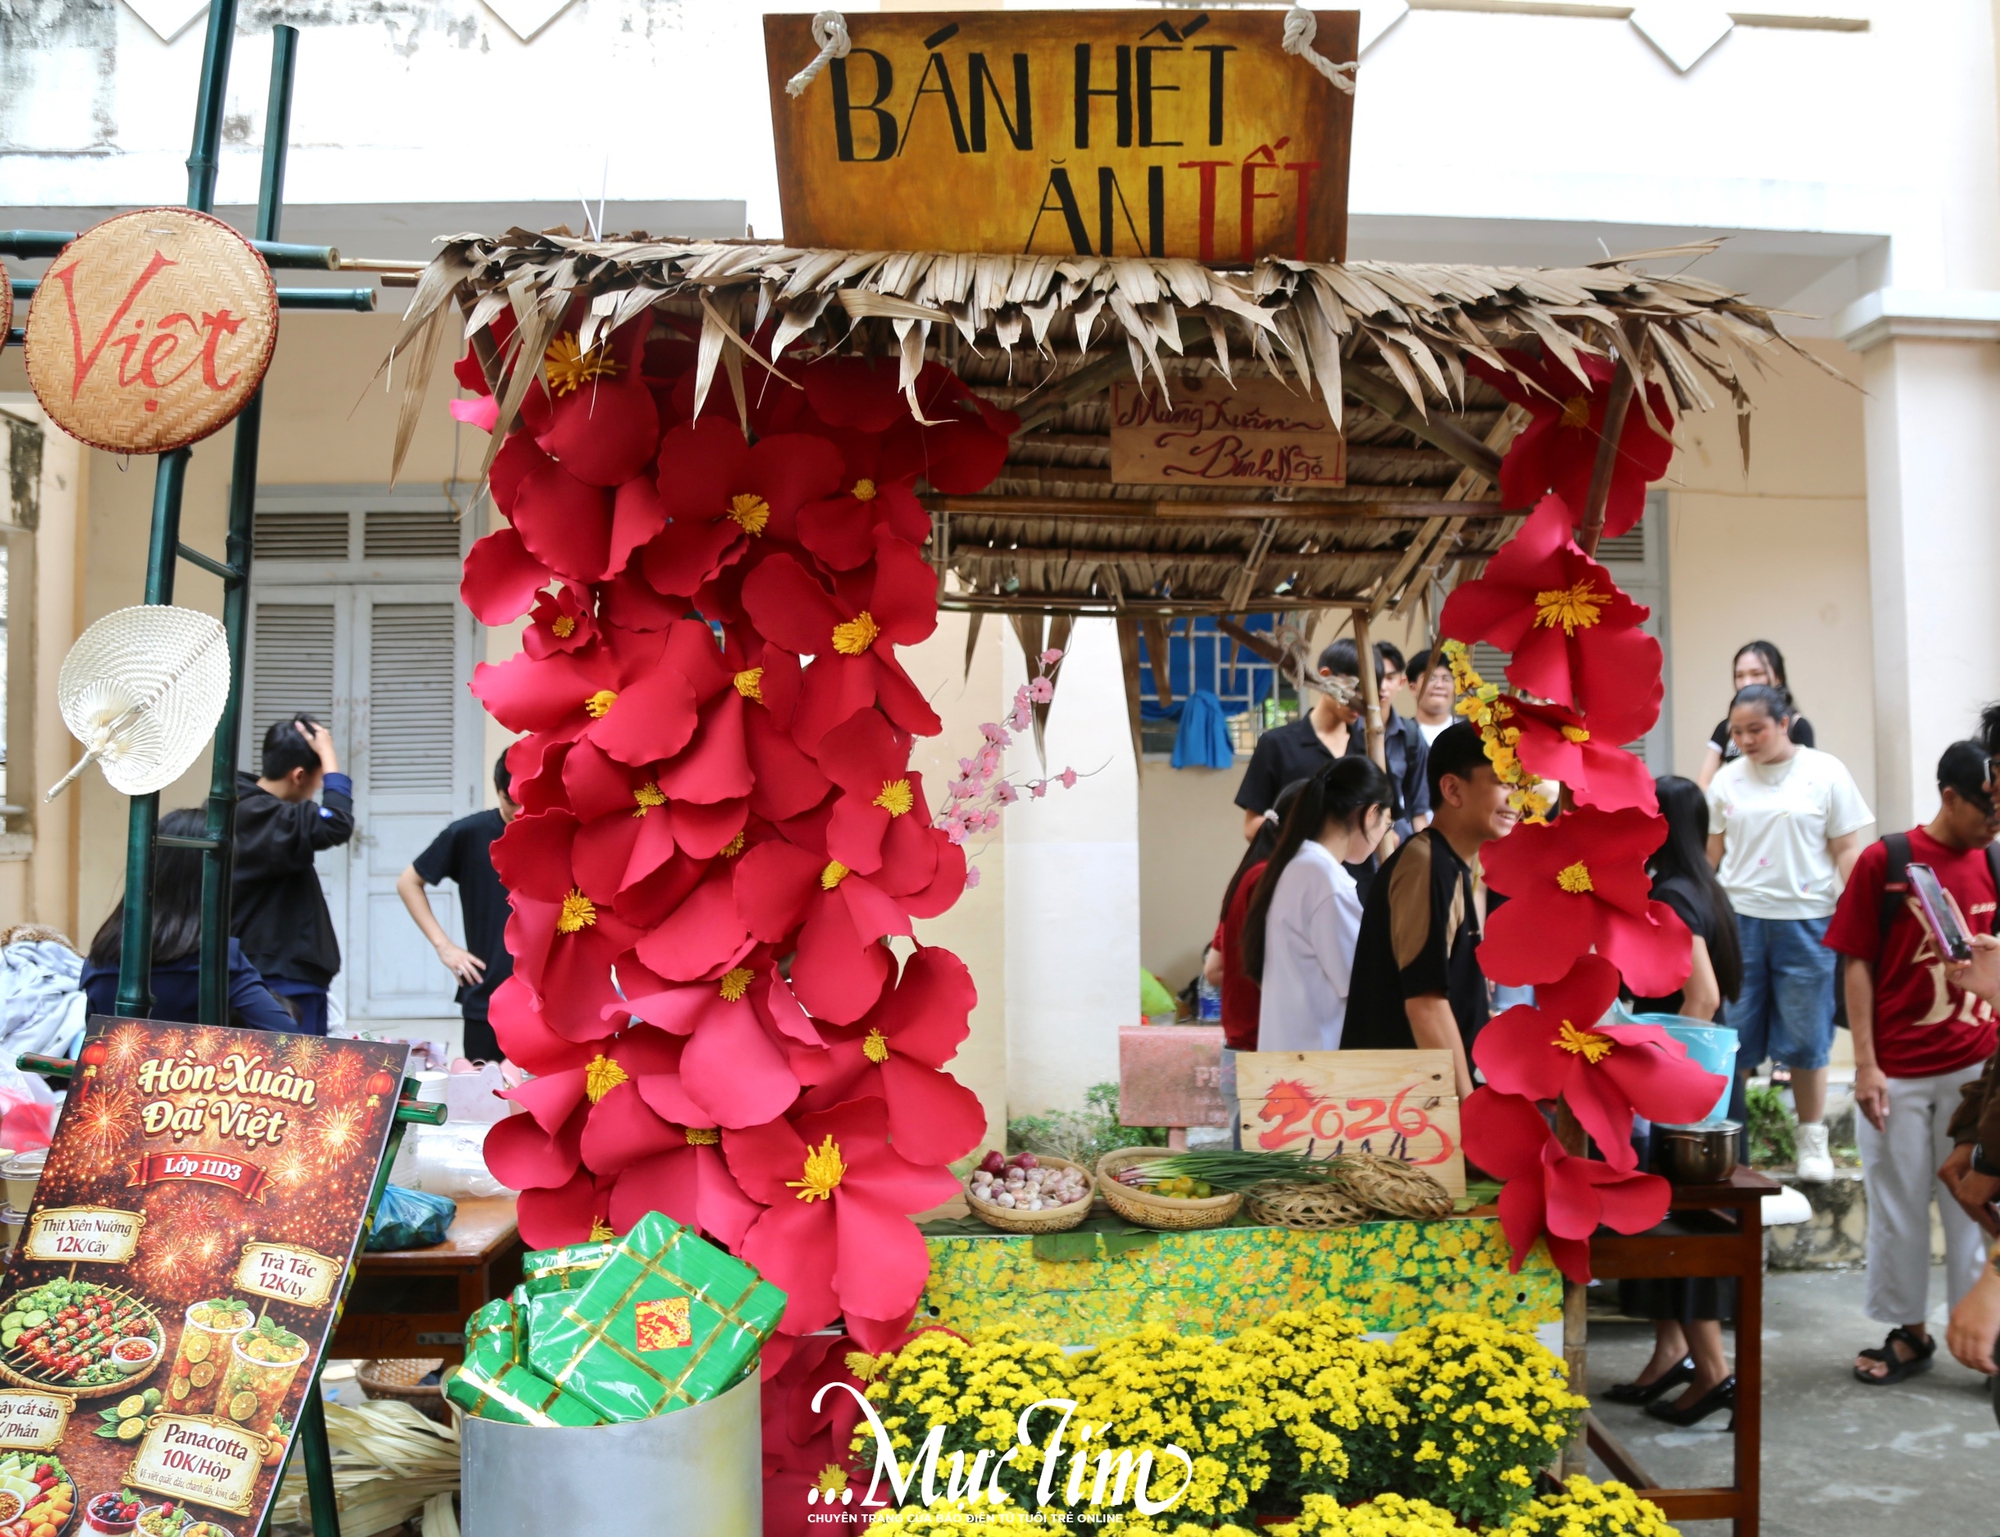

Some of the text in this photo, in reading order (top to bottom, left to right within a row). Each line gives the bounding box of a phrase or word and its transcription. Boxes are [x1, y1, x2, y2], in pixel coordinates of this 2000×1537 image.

[829, 13, 1238, 162] BÁN HẾT
[1024, 136, 1322, 262] ĂN TẾT
[53, 249, 247, 412] Việt
[137, 1049, 316, 1105] Hồn Xuân
[141, 1100, 286, 1147] Đại Việt
[1258, 1078, 1454, 1166] 2026
[164, 1156, 243, 1180] Lớp 11D3
[43, 1218, 132, 1237] Thịt Xiên Nướng
[56, 1236, 109, 1256] 12K/Cây
[260, 1252, 317, 1278] Trà Tắc
[259, 1272, 307, 1300] 12K/Ly
[0, 1400, 16, 1418] ây
[37, 1400, 59, 1419] sẵn
[163, 1423, 249, 1461] Panacotta
[162, 1449, 232, 1483] 10K/Hộp
